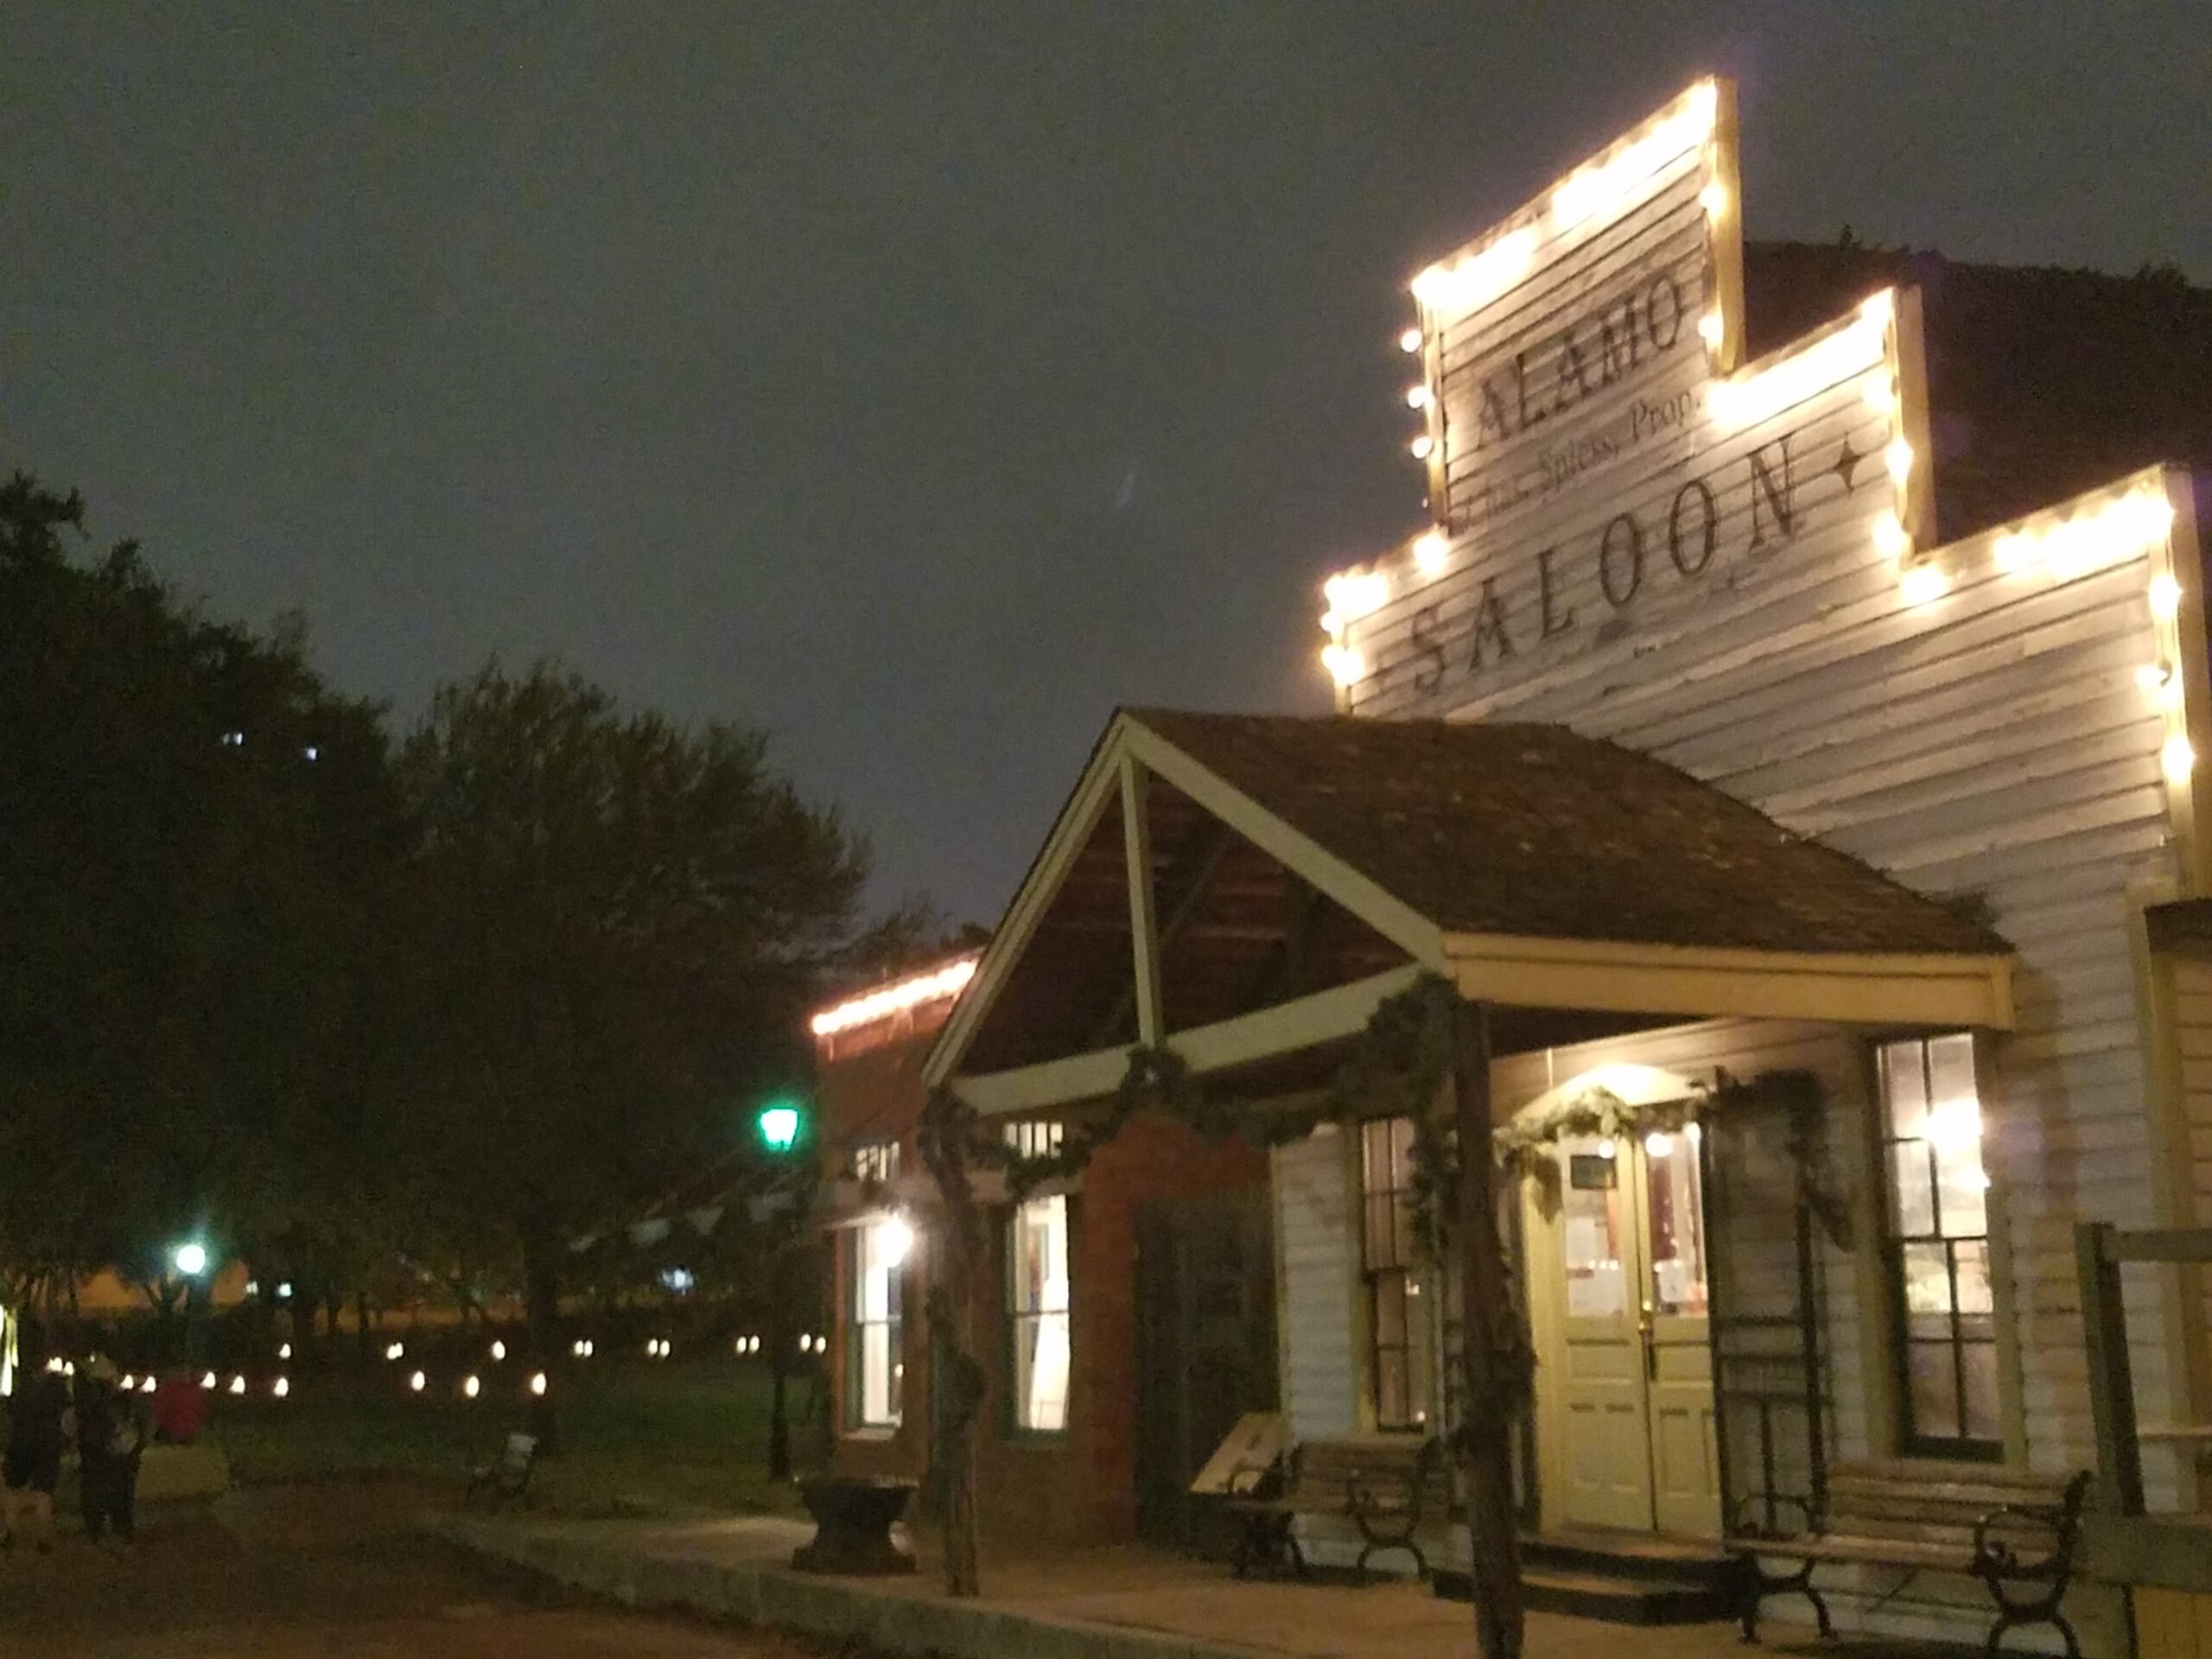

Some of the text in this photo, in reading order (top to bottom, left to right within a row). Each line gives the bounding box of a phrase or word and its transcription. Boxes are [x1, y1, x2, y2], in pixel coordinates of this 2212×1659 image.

[1477, 274, 1683, 448] ALAMO
[1628, 391, 1702, 442] Prop.
[1414, 431, 1799, 691] SALOON
